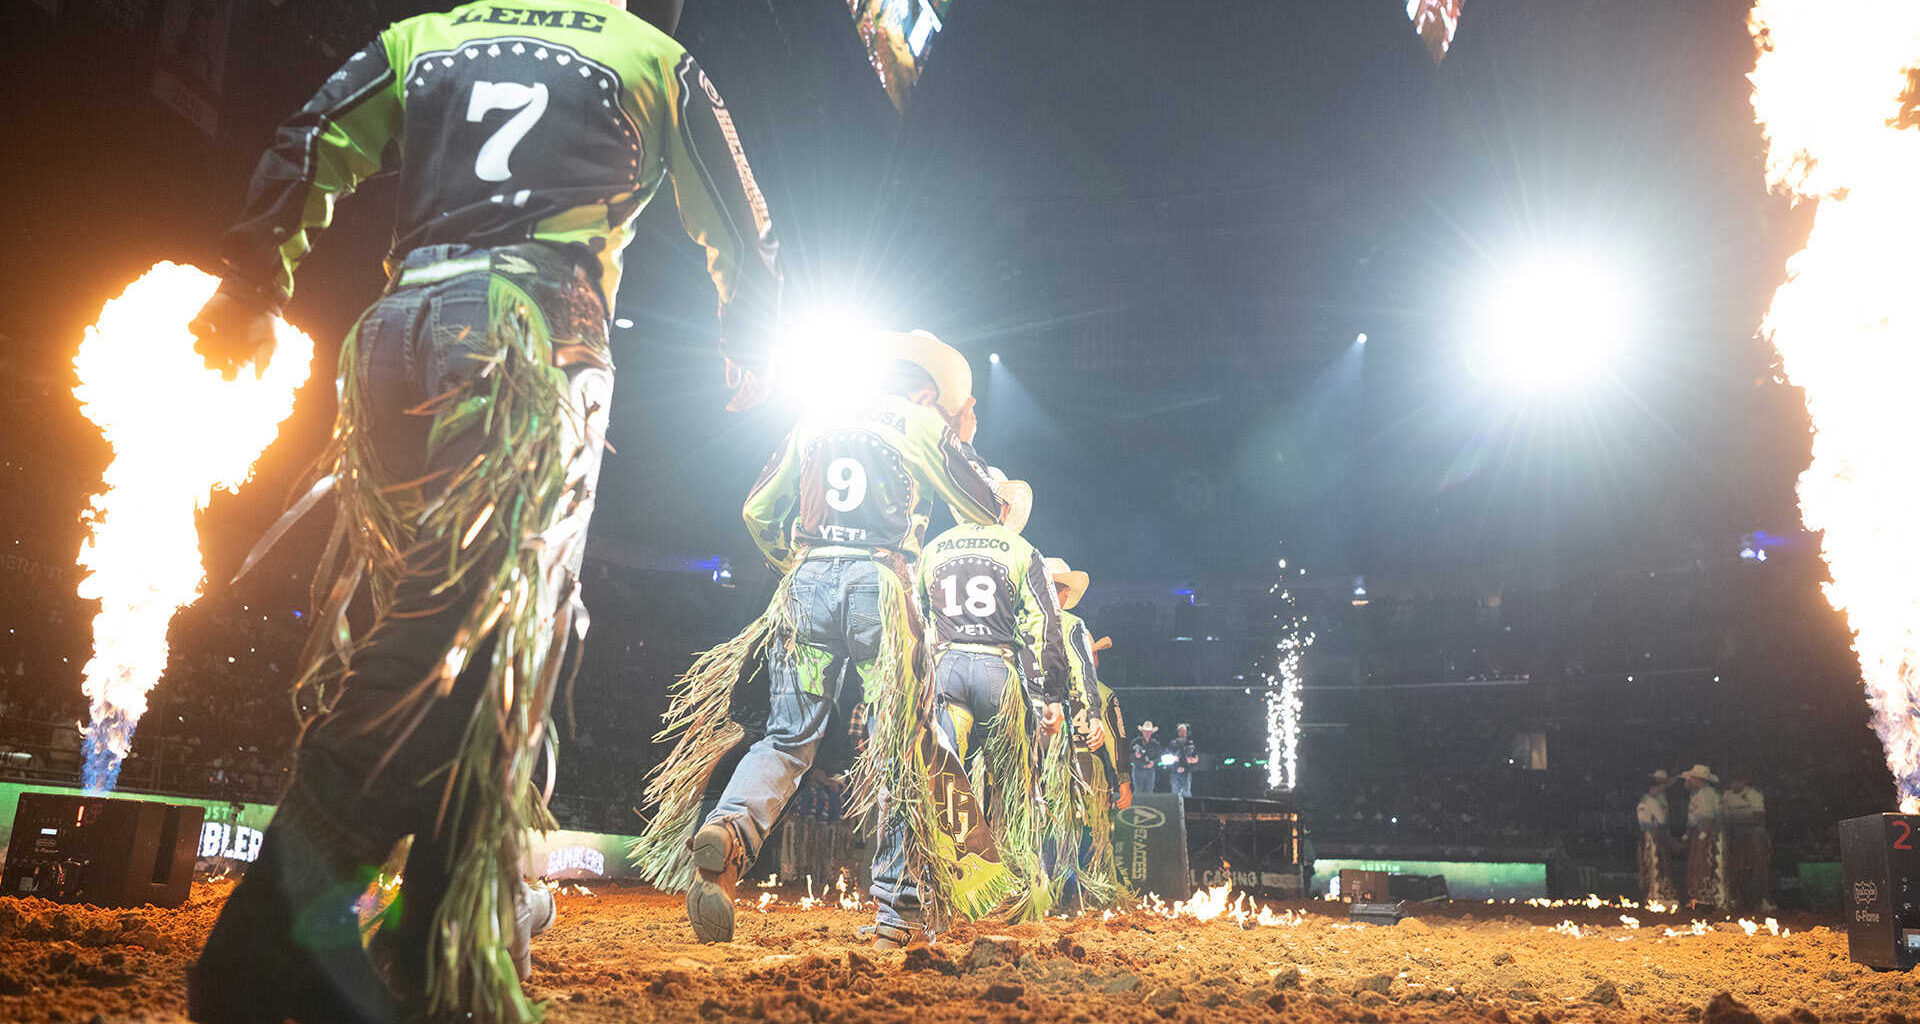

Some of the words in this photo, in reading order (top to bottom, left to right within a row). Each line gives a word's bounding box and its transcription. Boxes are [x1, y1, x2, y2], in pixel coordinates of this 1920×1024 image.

[451, 7, 607, 33] LEME
[466, 80, 549, 182] 7
[825, 457, 867, 512] 9
[936, 538, 1010, 553] PACHECO
[940, 574, 997, 617] 18
[197, 821, 264, 863] BLER
[1892, 820, 1912, 850] 2
[1190, 868, 1199, 887] L
[1360, 863, 1400, 872] AUSTIN
